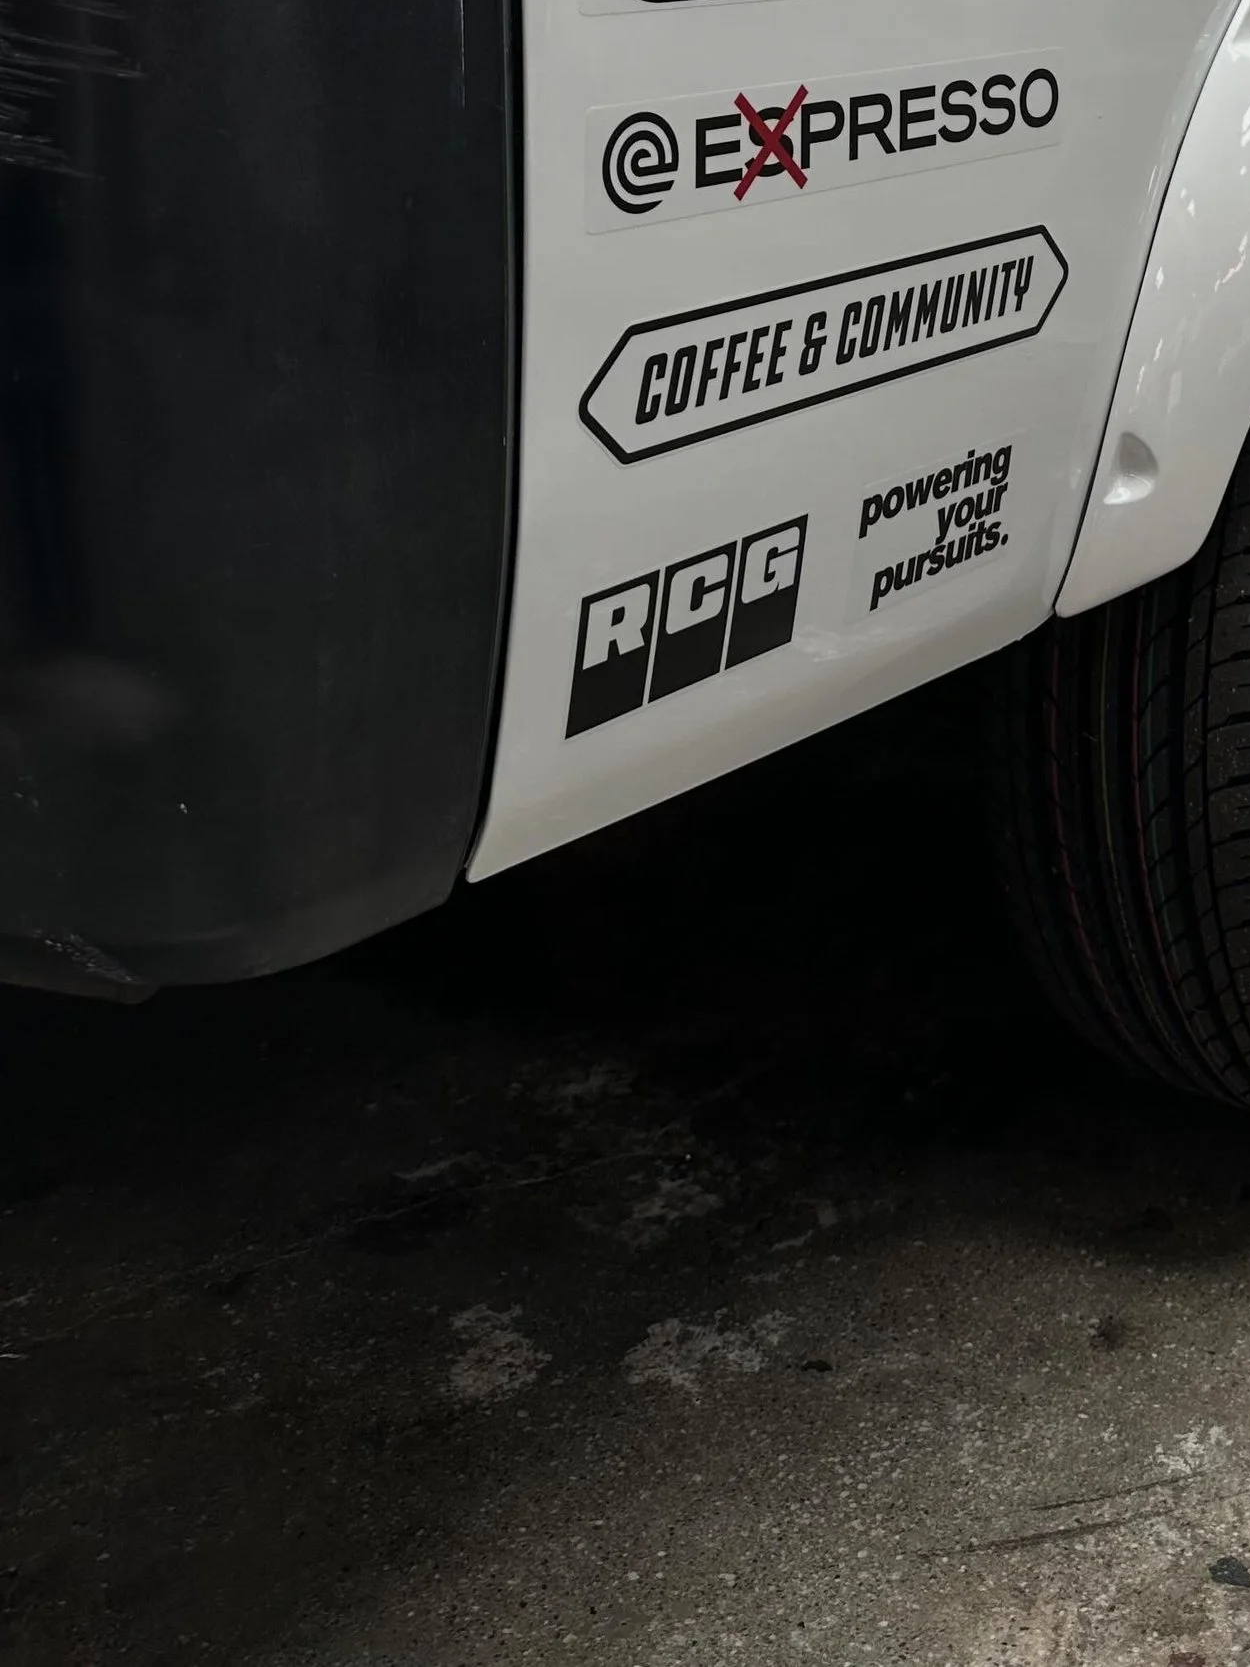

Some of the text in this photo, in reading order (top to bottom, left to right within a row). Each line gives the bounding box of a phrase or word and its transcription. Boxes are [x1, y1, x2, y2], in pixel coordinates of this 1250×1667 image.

[635, 255, 1035, 425] COFFEE & COMMUNITY
[858, 445, 1012, 539] powering
[937, 481, 1008, 544] your
[582, 524, 800, 671] RCG
[869, 520, 1009, 611] pursuits.
